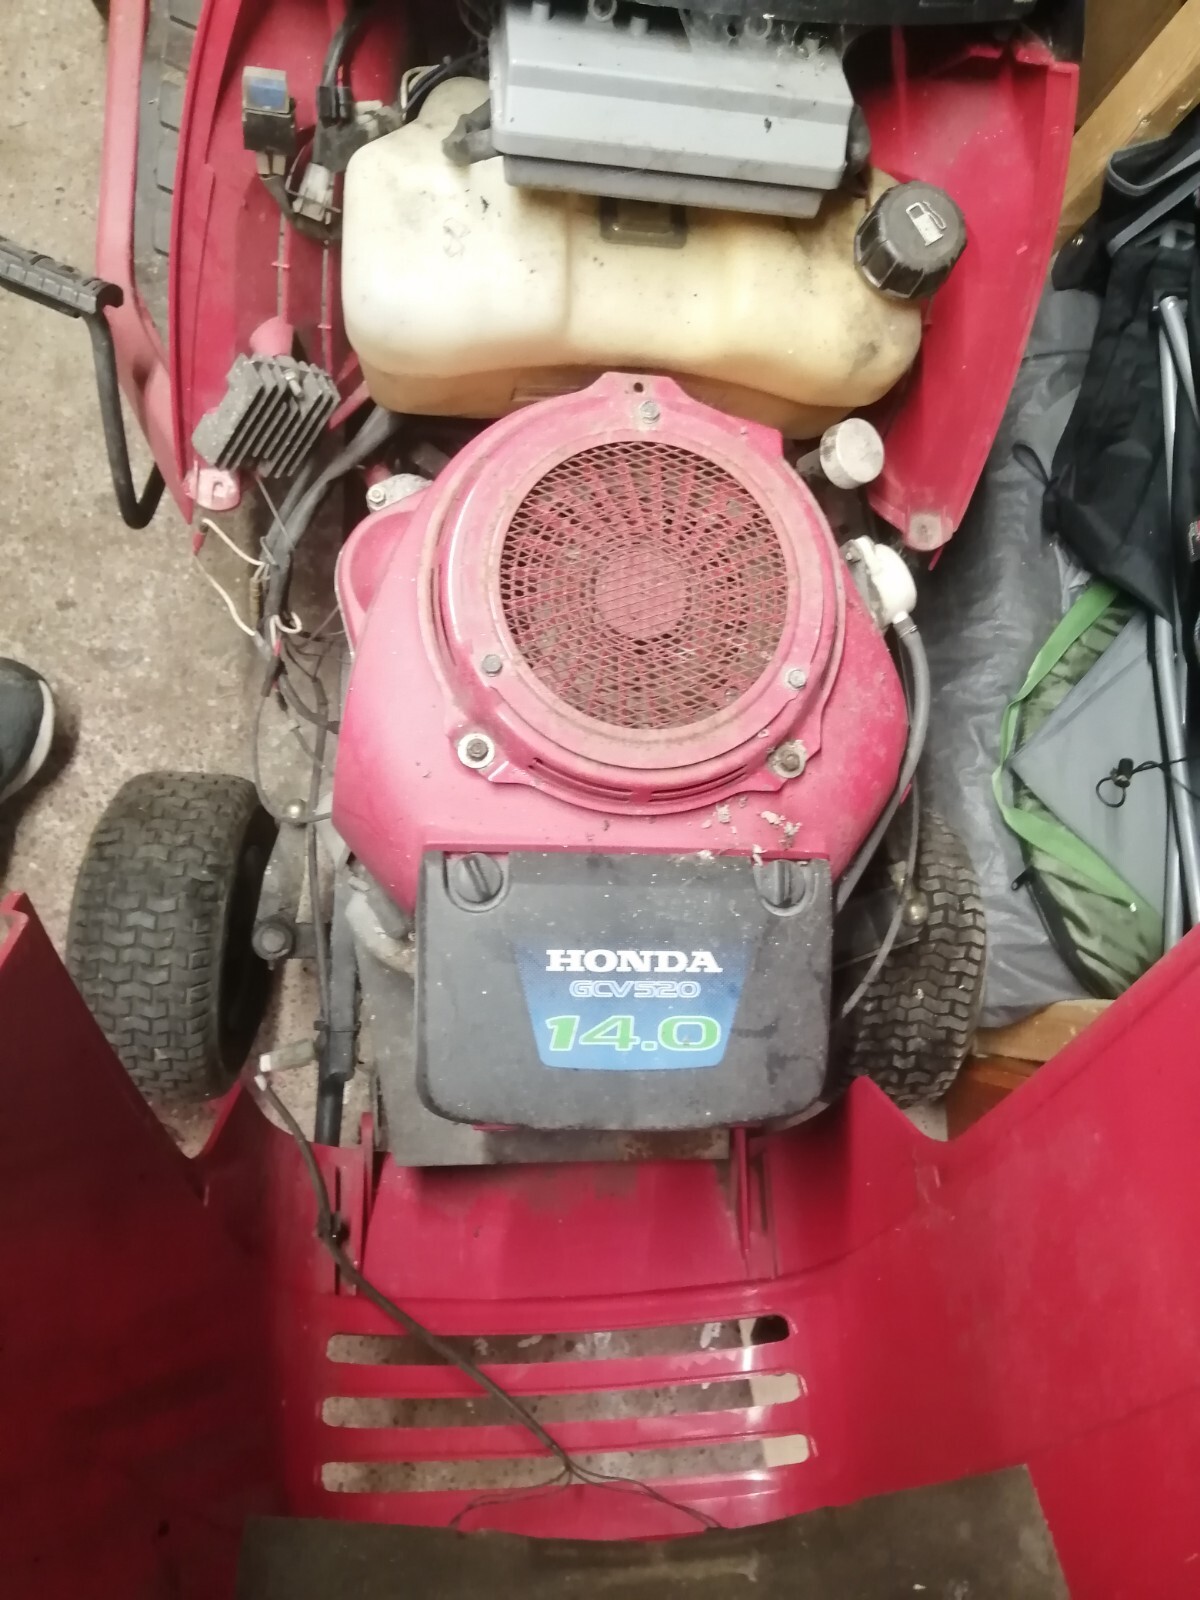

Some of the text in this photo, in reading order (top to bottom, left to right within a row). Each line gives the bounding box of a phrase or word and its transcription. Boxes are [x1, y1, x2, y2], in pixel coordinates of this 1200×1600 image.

[546, 949, 723, 973] HONDA
[569, 980, 701, 998] GCV520
[545, 1015, 721, 1051] 14.0
